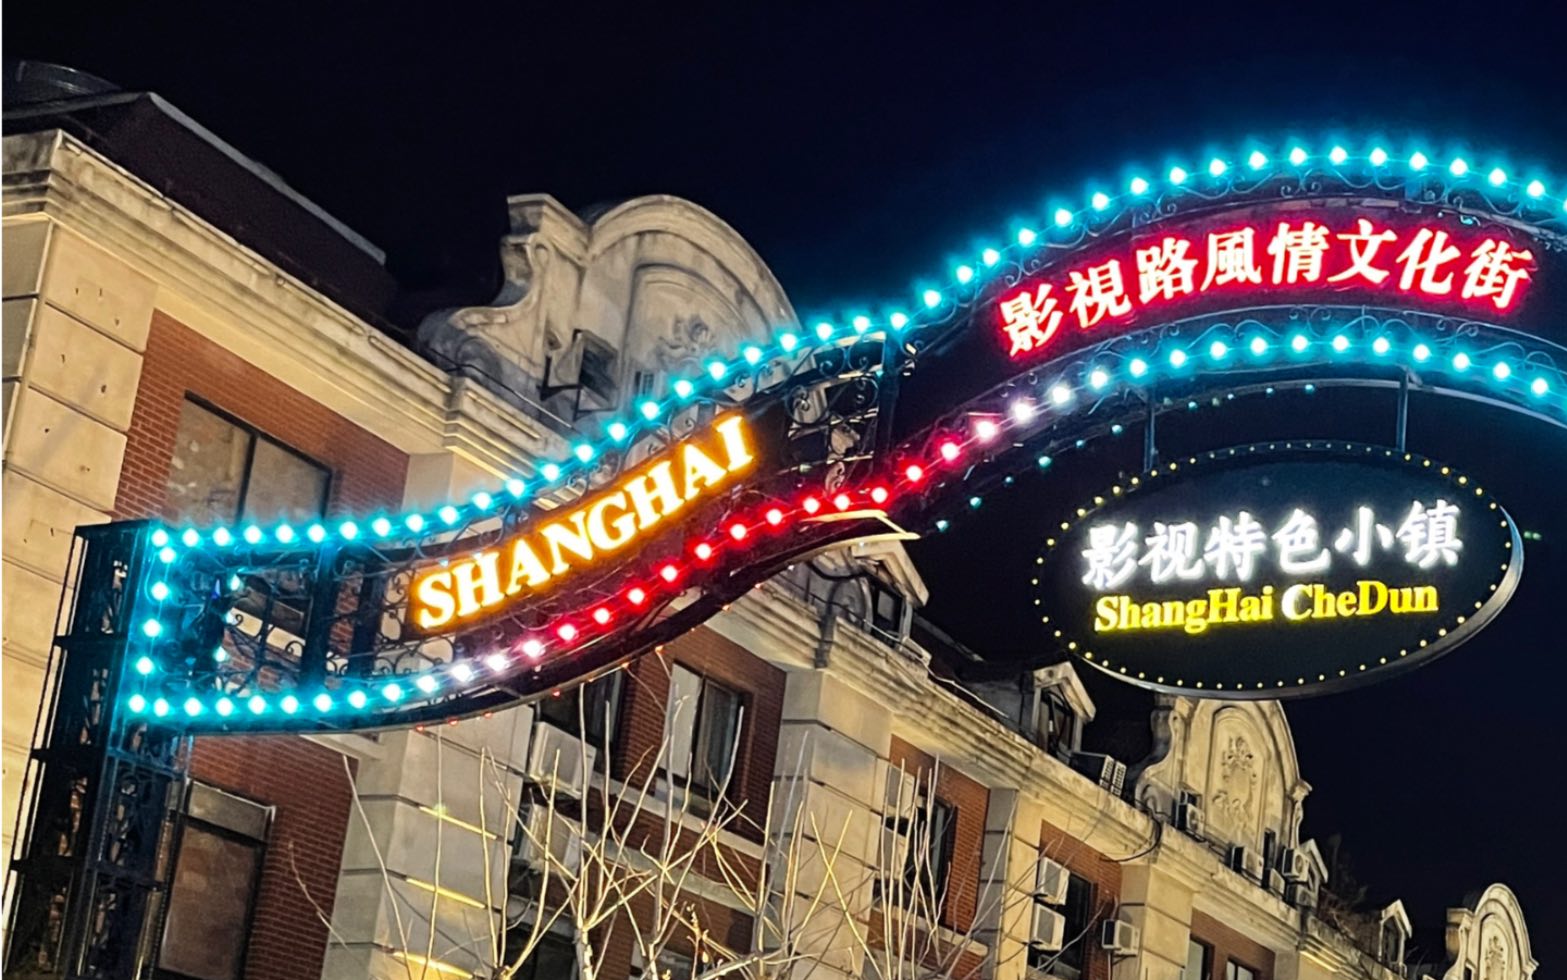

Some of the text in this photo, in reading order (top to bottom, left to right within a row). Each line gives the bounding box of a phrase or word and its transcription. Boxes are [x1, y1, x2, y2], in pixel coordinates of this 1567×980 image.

[1001, 219, 1532, 356] 影視路風情文化街
[416, 415, 754, 629] SHANGHAI
[1081, 499, 1463, 590] 影视特色小镇
[1094, 580, 1439, 635] ShangHai CheDun
